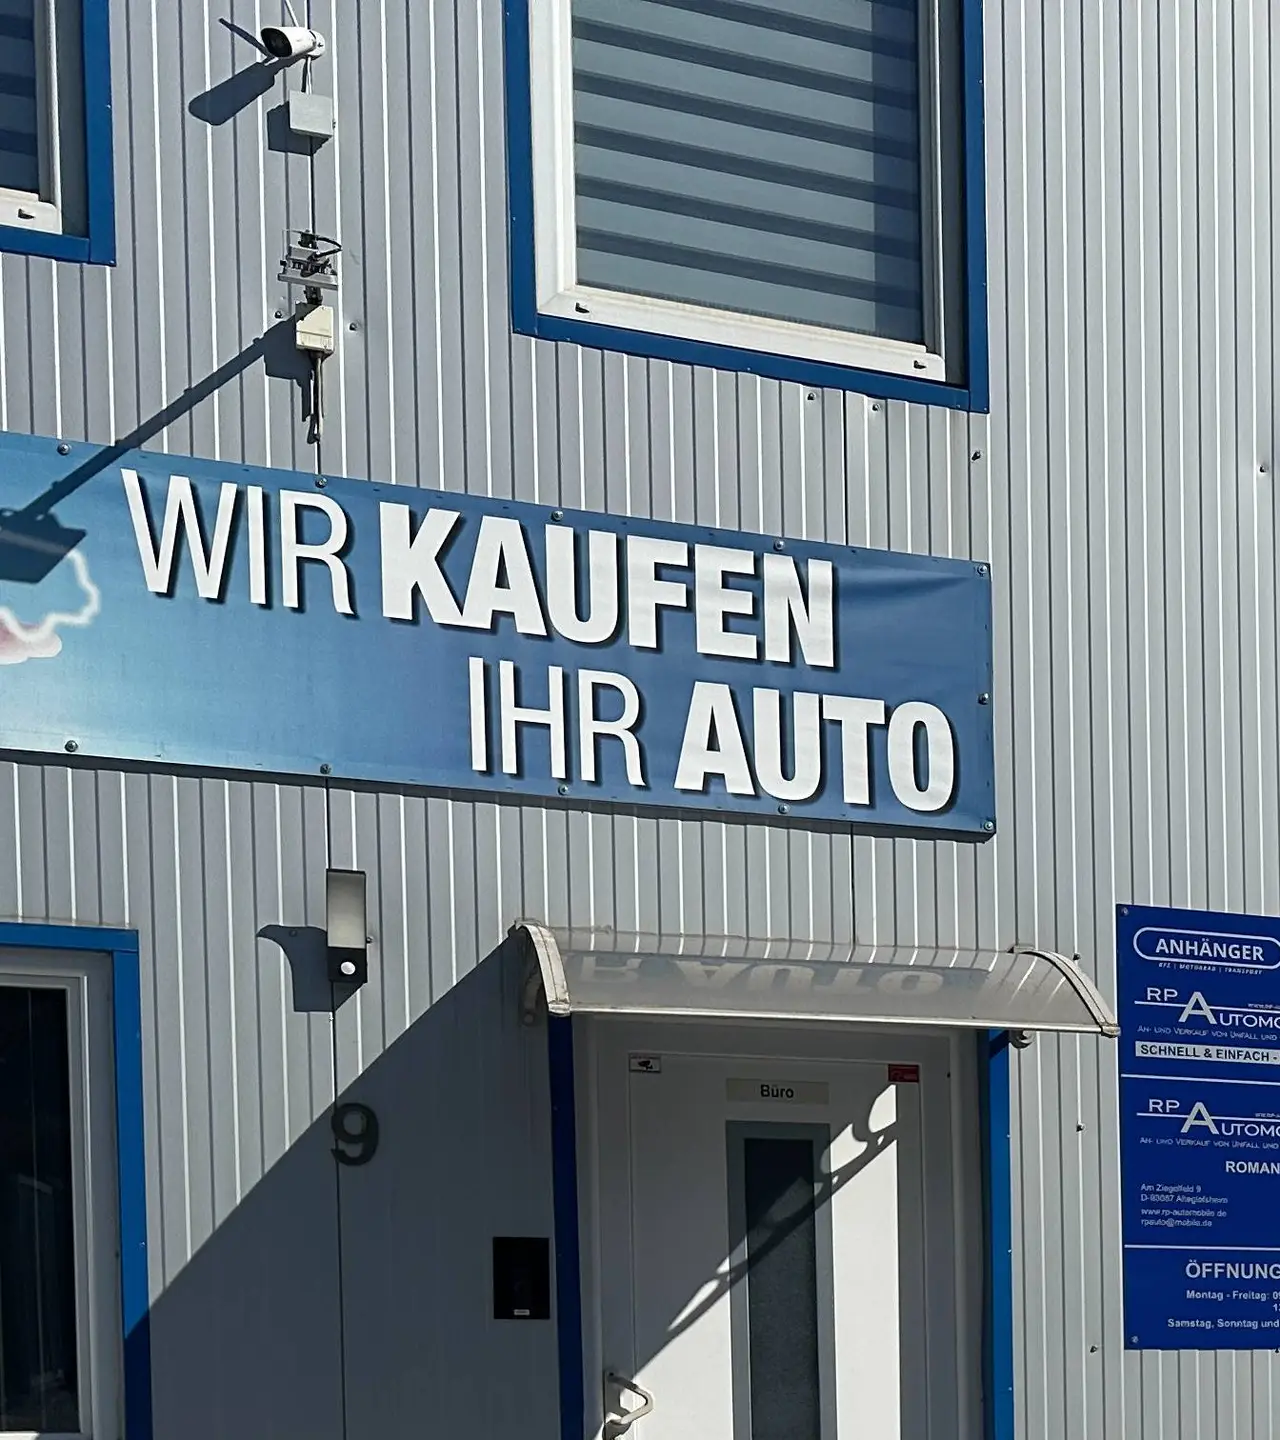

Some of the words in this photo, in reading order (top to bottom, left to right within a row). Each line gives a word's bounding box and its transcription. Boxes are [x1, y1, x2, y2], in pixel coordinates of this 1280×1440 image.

[120, 467, 356, 618] WIR
[379, 500, 836, 669] KAUFEN
[467, 656, 646, 787] IHR
[674, 681, 955, 814] AUTO
[1155, 936, 1265, 961] ANHÄNGER
[1147, 987, 1178, 1001] RP
[1140, 1044, 1200, 1058] SCHNELL
[1203, 1047, 1213, 1058] &
[1216, 1049, 1270, 1062] EINFACH
[760, 1084, 794, 1099] Büro
[1148, 1098, 1180, 1113] RP
[331, 1102, 379, 1167] 9
[1225, 1160, 1280, 1174] ROMAN
[1186, 1289, 1224, 1301] Montag
[1167, 1318, 1215, 1330] Samstag,
[1217, 1318, 1258, 1330] Sonntag
[1261, 1319, 1279, 1328] und
